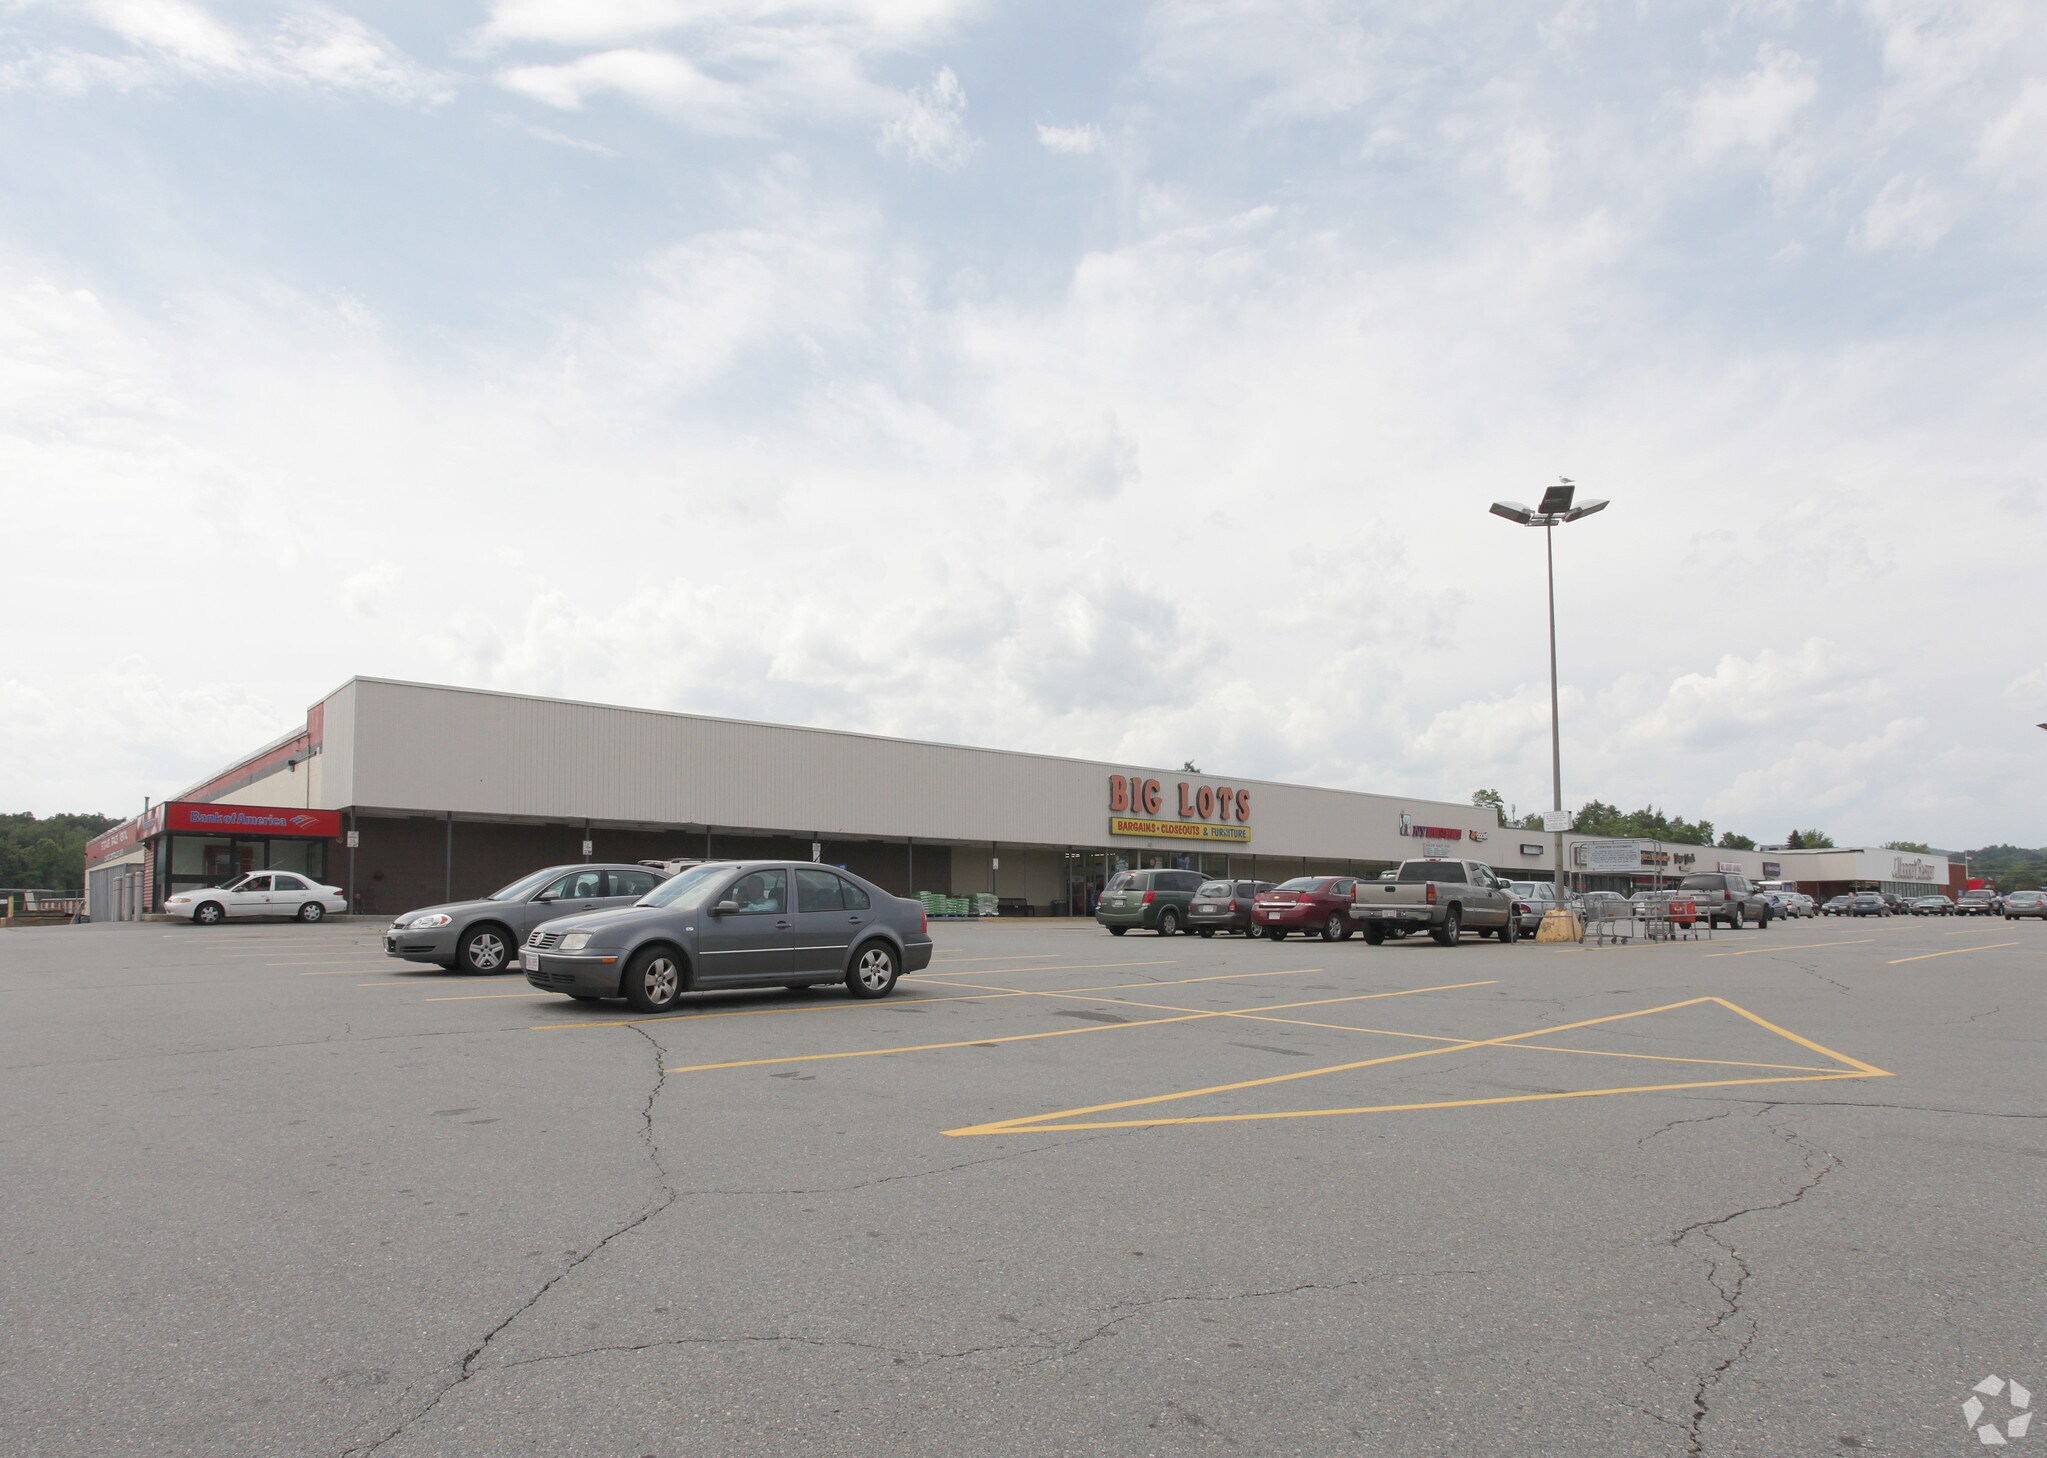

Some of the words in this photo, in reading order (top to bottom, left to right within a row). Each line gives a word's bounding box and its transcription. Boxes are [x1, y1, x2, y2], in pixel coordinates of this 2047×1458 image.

[1109, 774, 1163, 815] BIG
[1177, 782, 1250, 822] LOTS
[190, 811, 223, 823] Bank
[223, 813, 236, 824] of
[237, 813, 287, 826] America
[1117, 820, 1156, 833] BARGAINS
[1160, 823, 1200, 836] CLOSEOUTS
[1202, 827, 1209, 837] &
[1211, 828, 1247, 839] FURNITURE
